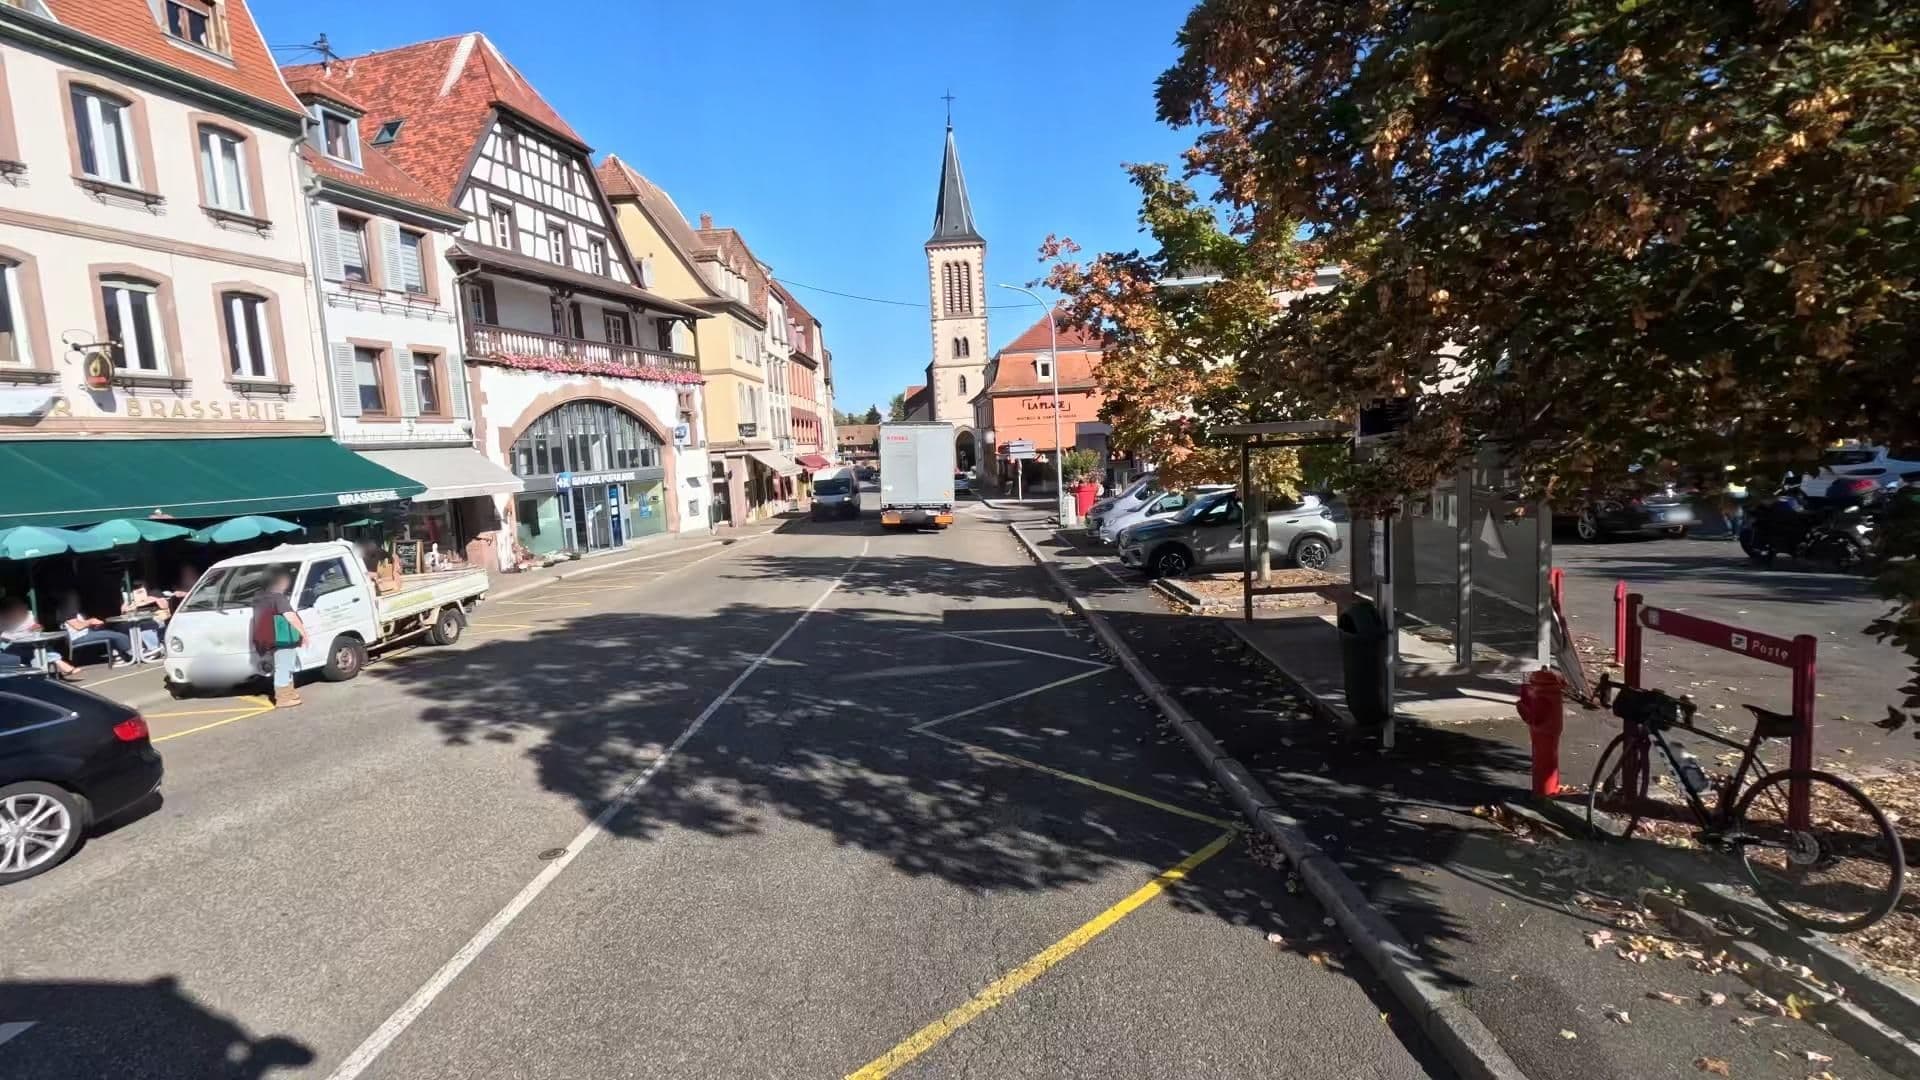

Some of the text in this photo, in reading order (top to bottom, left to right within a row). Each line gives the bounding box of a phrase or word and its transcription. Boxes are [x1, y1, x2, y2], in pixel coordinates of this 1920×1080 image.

[127, 398, 287, 420] BRASSERIE
[1028, 400, 1065, 410] LA PLAE
[337, 491, 400, 505] BRASSERIE
[1752, 640, 1789, 661] Poste
